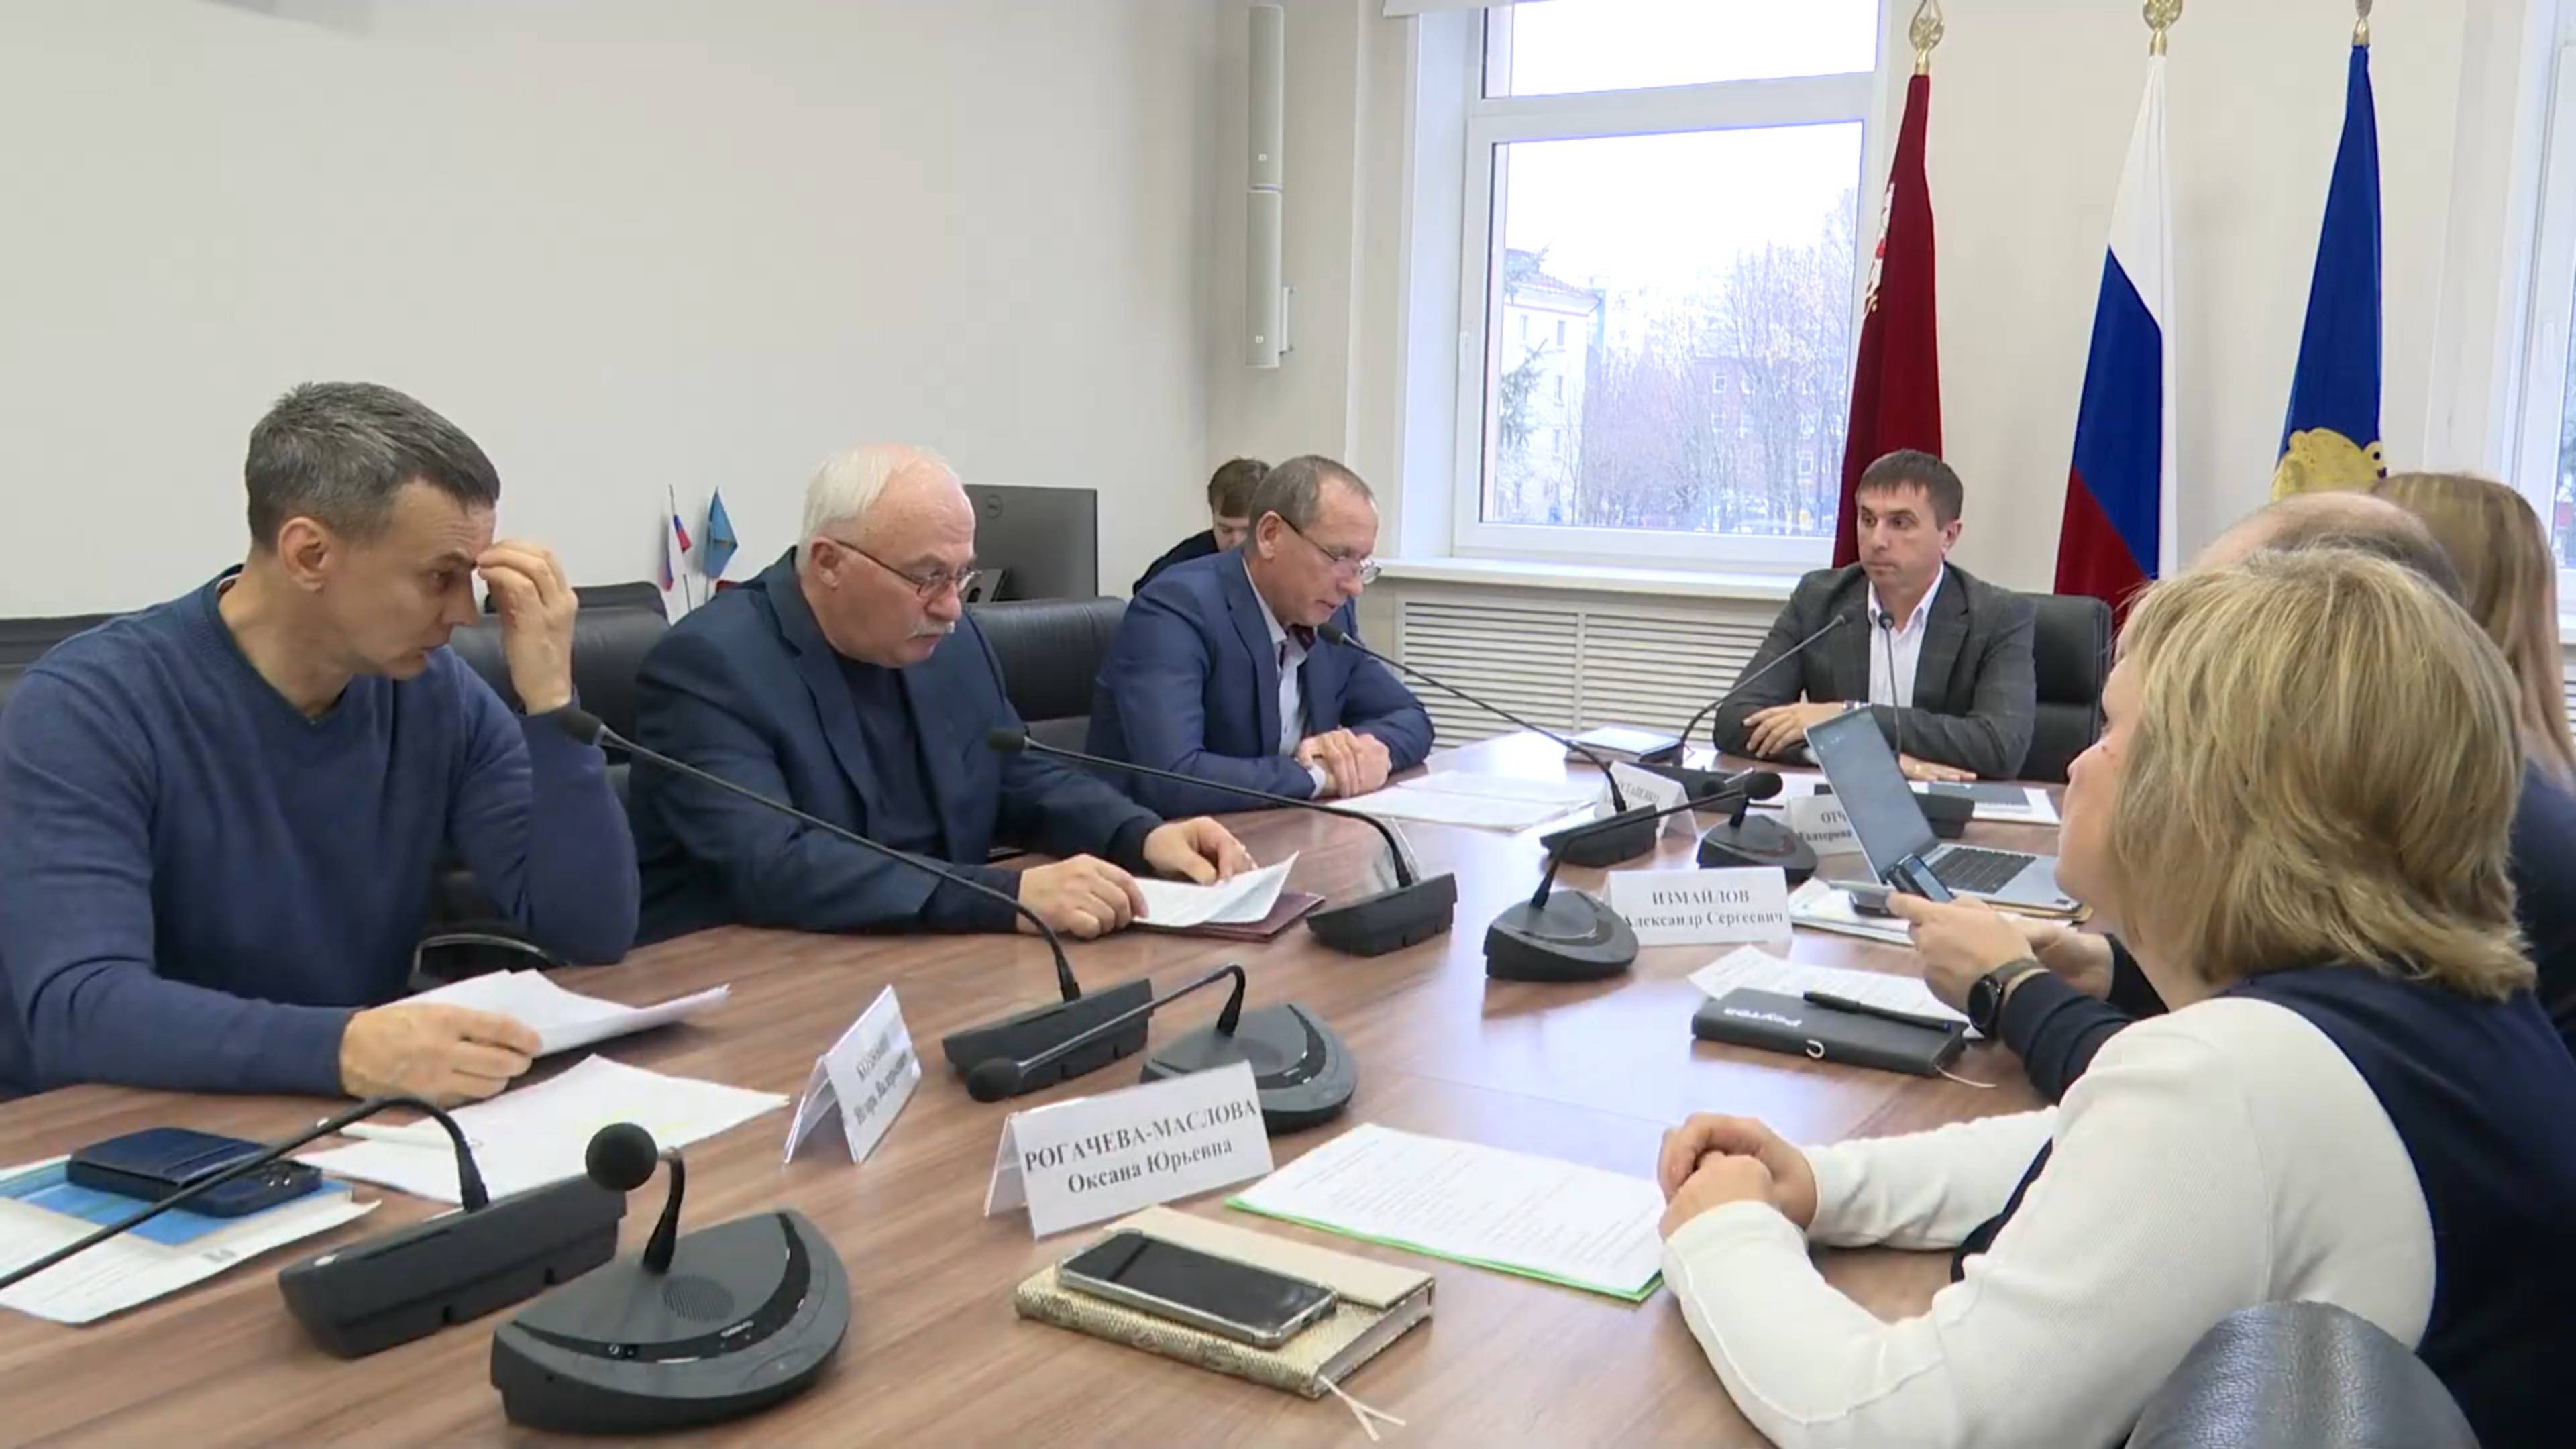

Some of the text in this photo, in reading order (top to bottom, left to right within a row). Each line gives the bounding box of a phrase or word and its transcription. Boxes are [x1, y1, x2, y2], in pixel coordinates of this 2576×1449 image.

[1821, 811, 1847, 824] ОТЧ
[1652, 888, 1750, 905] ИЗМАЙЛОВ
[1625, 911, 1783, 928] Александр Сергеевич
[1024, 1099, 1257, 1173] РОГАЧЕВА-МАСЛОВА
[1068, 1139, 1233, 1193] Оксана Юрьевна
